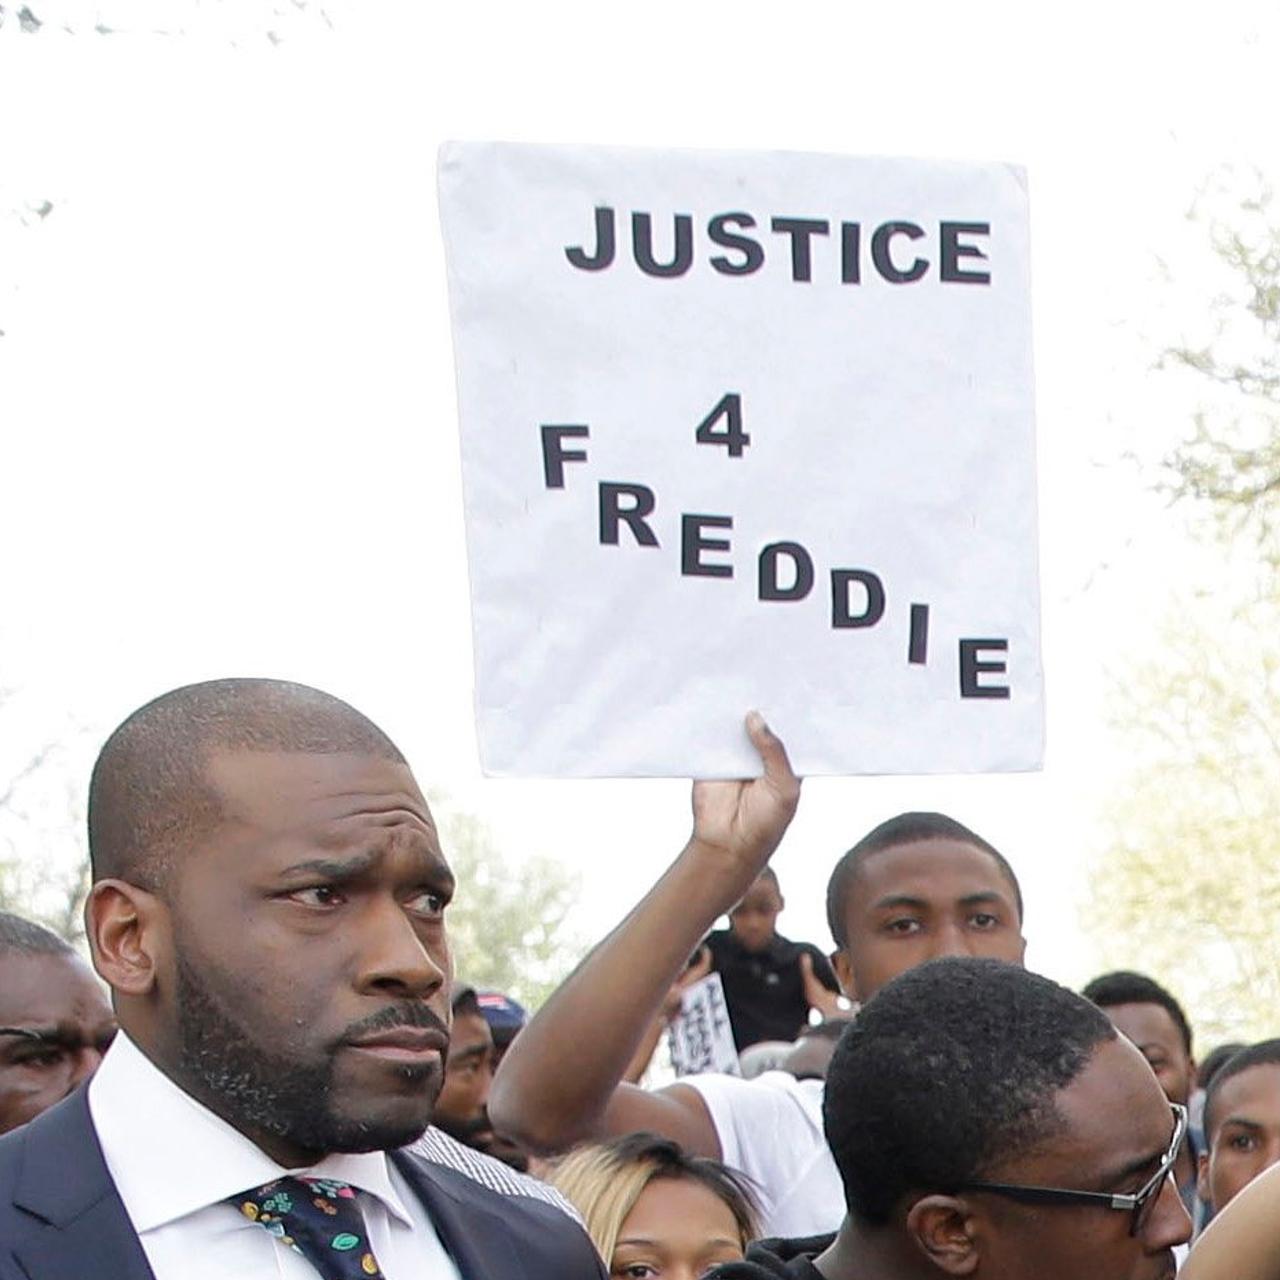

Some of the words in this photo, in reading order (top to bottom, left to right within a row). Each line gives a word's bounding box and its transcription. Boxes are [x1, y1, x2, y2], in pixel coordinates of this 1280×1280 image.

[564, 205, 992, 287] JUSTICE
[695, 392, 751, 458] 4
[540, 424, 1010, 700] FREDDIE
